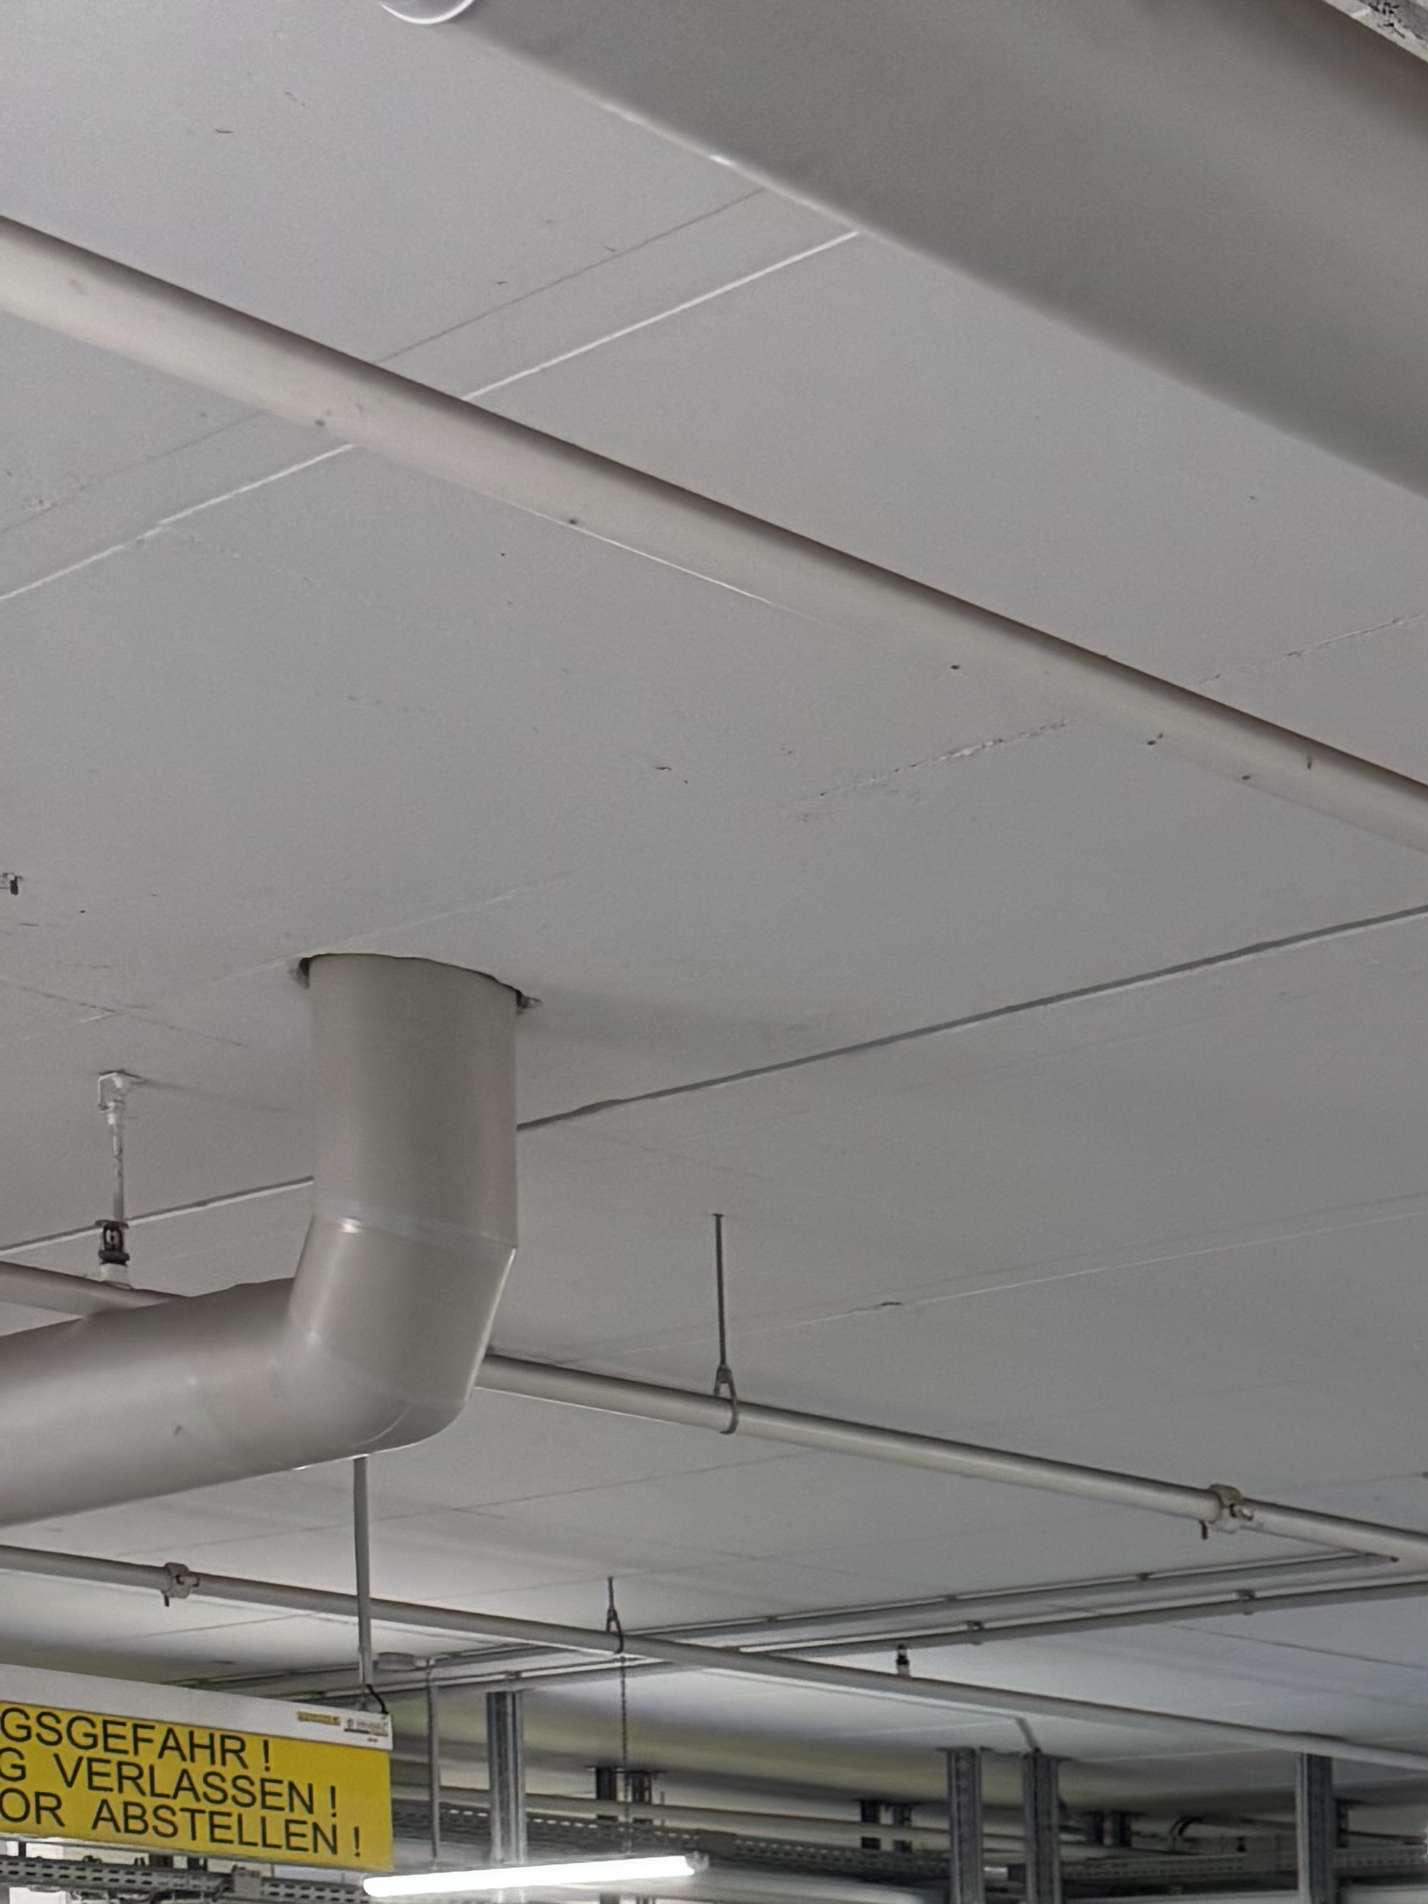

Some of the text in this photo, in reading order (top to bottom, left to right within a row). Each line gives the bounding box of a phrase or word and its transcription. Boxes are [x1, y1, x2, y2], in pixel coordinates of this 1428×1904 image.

[0, 1707, 248, 1769] GSGEFAHR
[53, 1753, 314, 1815] VERLASSEN
[0, 1787, 64, 1827] OR
[92, 1799, 338, 1856] ABSTELLEN
